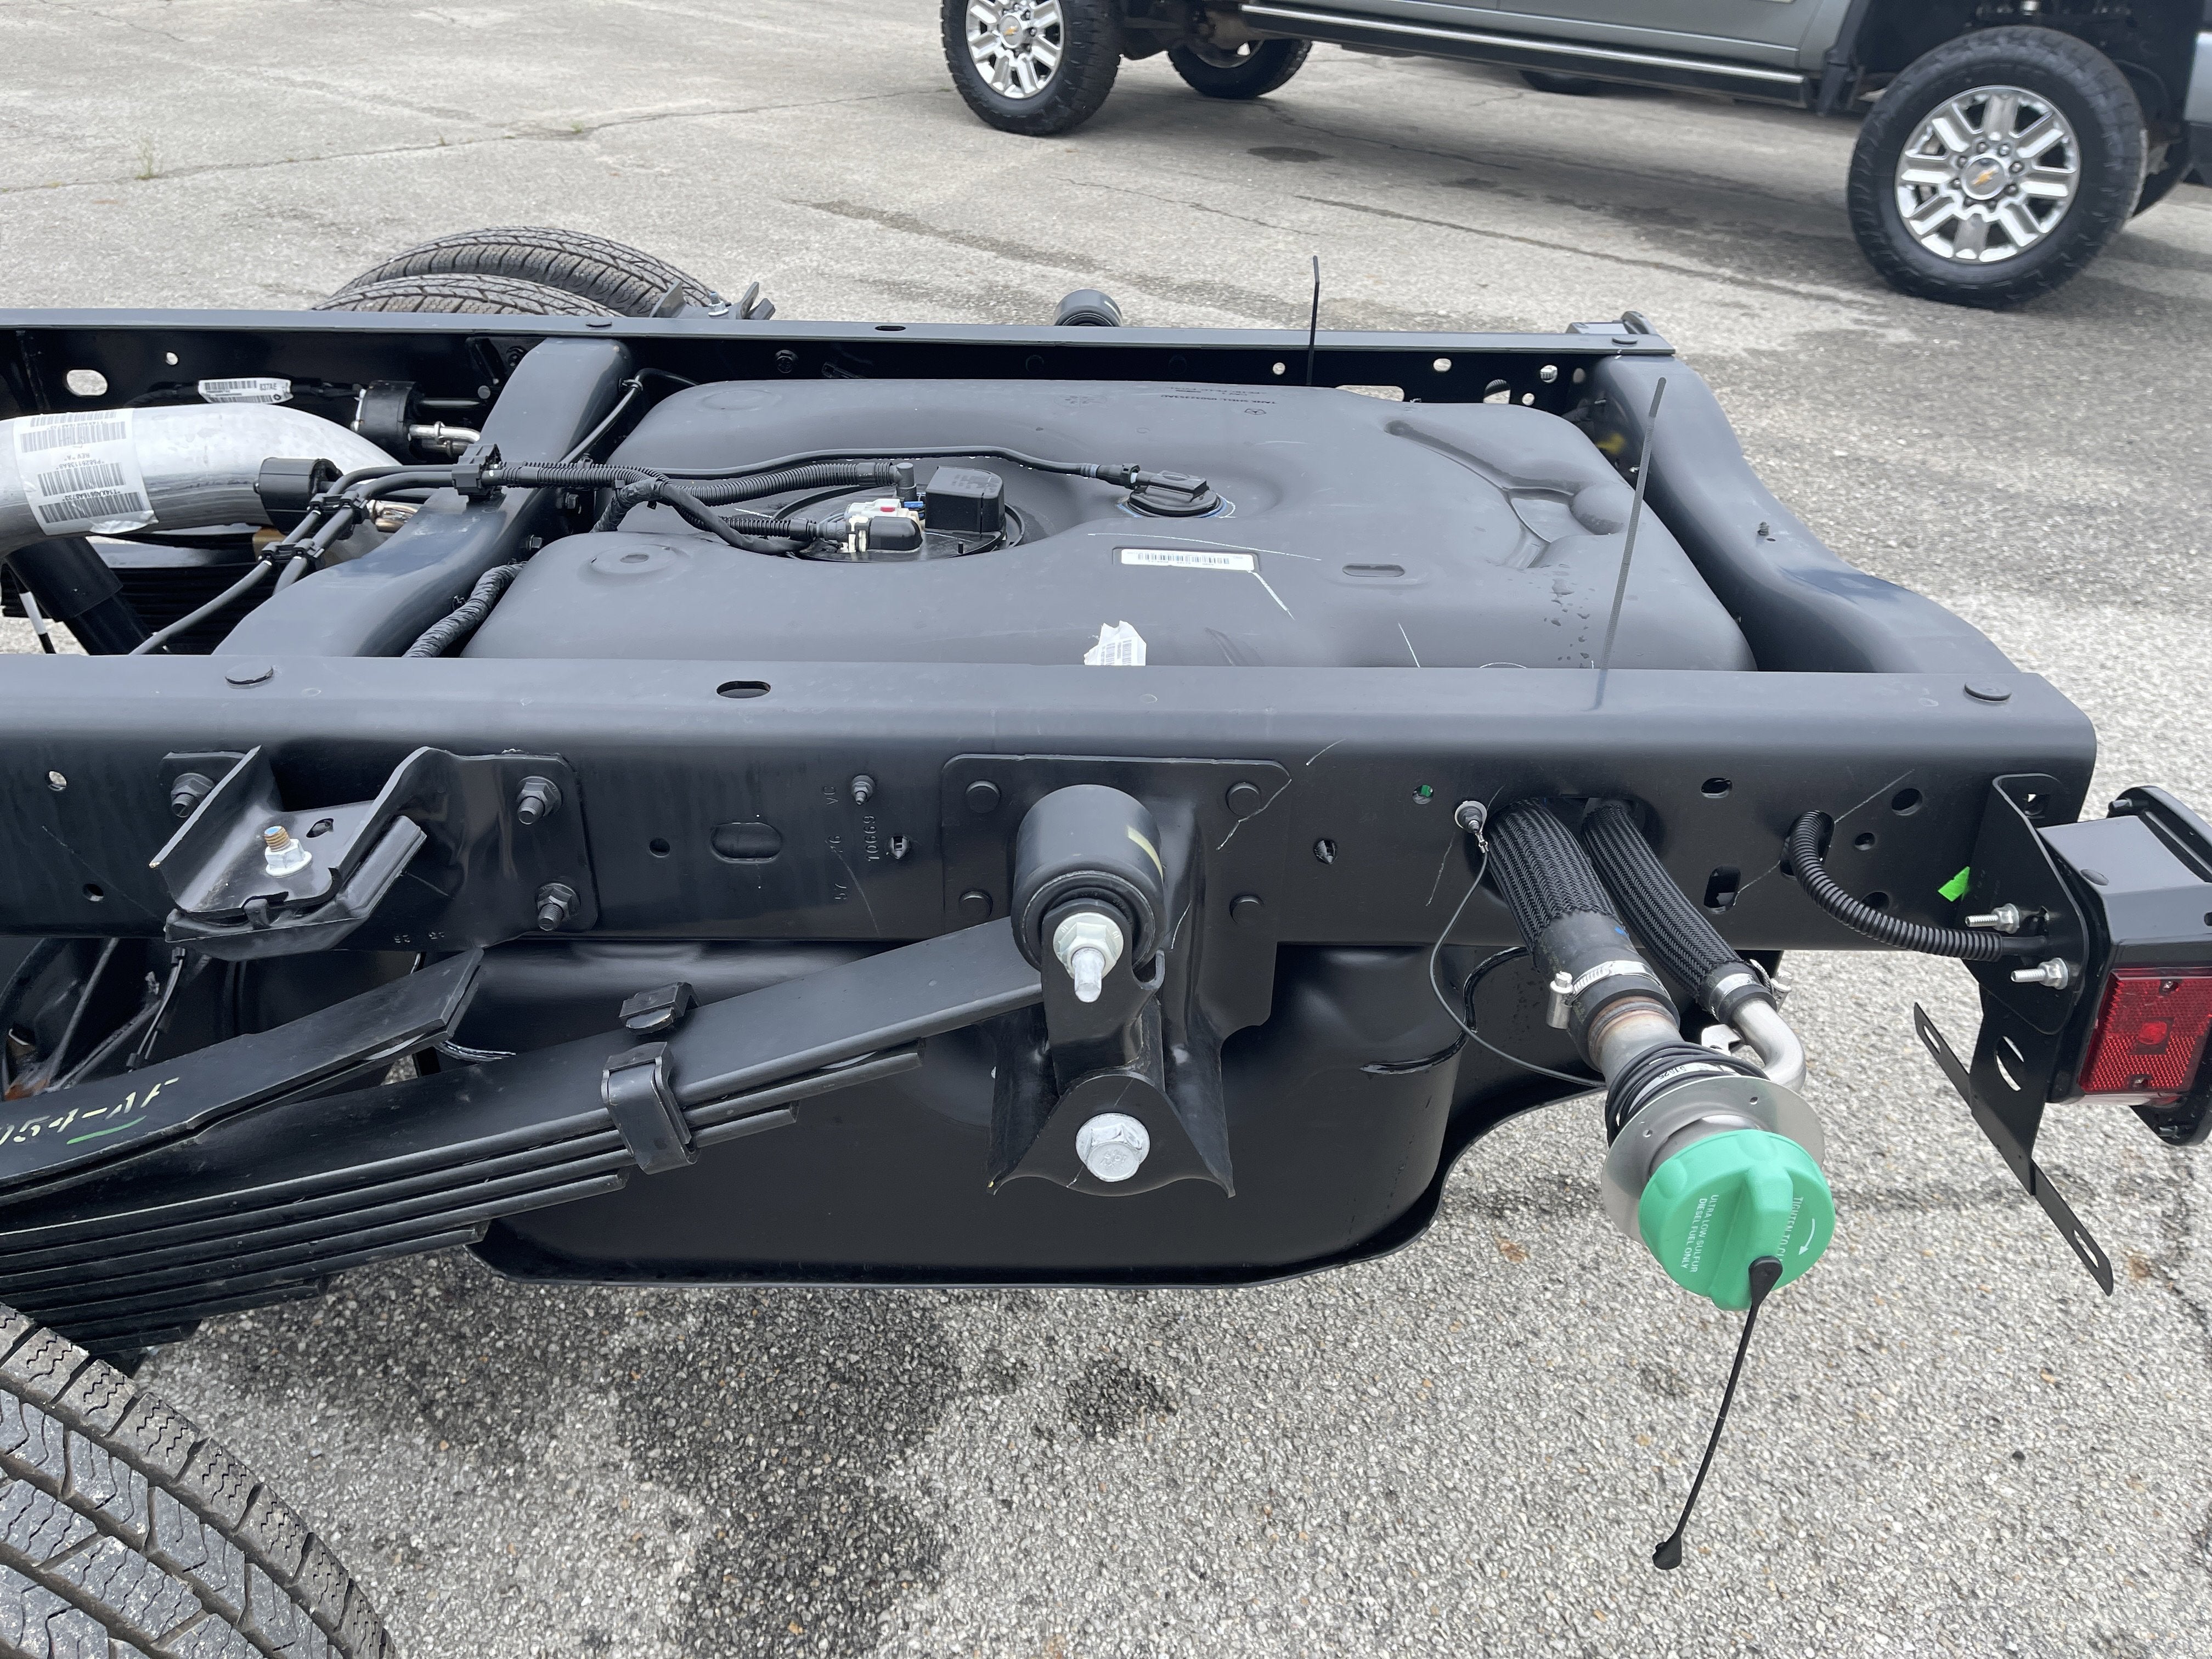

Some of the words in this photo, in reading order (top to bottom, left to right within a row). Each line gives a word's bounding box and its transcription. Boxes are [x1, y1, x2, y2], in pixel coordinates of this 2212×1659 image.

[862, 815, 880, 862] 10669
[1692, 1198, 1708, 1224] DIESEL
[1704, 1194, 1719, 1218] ULTRA
[1785, 1197, 1804, 1232] TIGHTEN
[1686, 1226, 1699, 1246] FUEL
[1699, 1220, 1710, 1238] LOW
[1779, 1234, 1791, 1245] TO
[1680, 1247, 1692, 1269] ONLY
[1690, 1240, 1704, 1273] SULFUR
